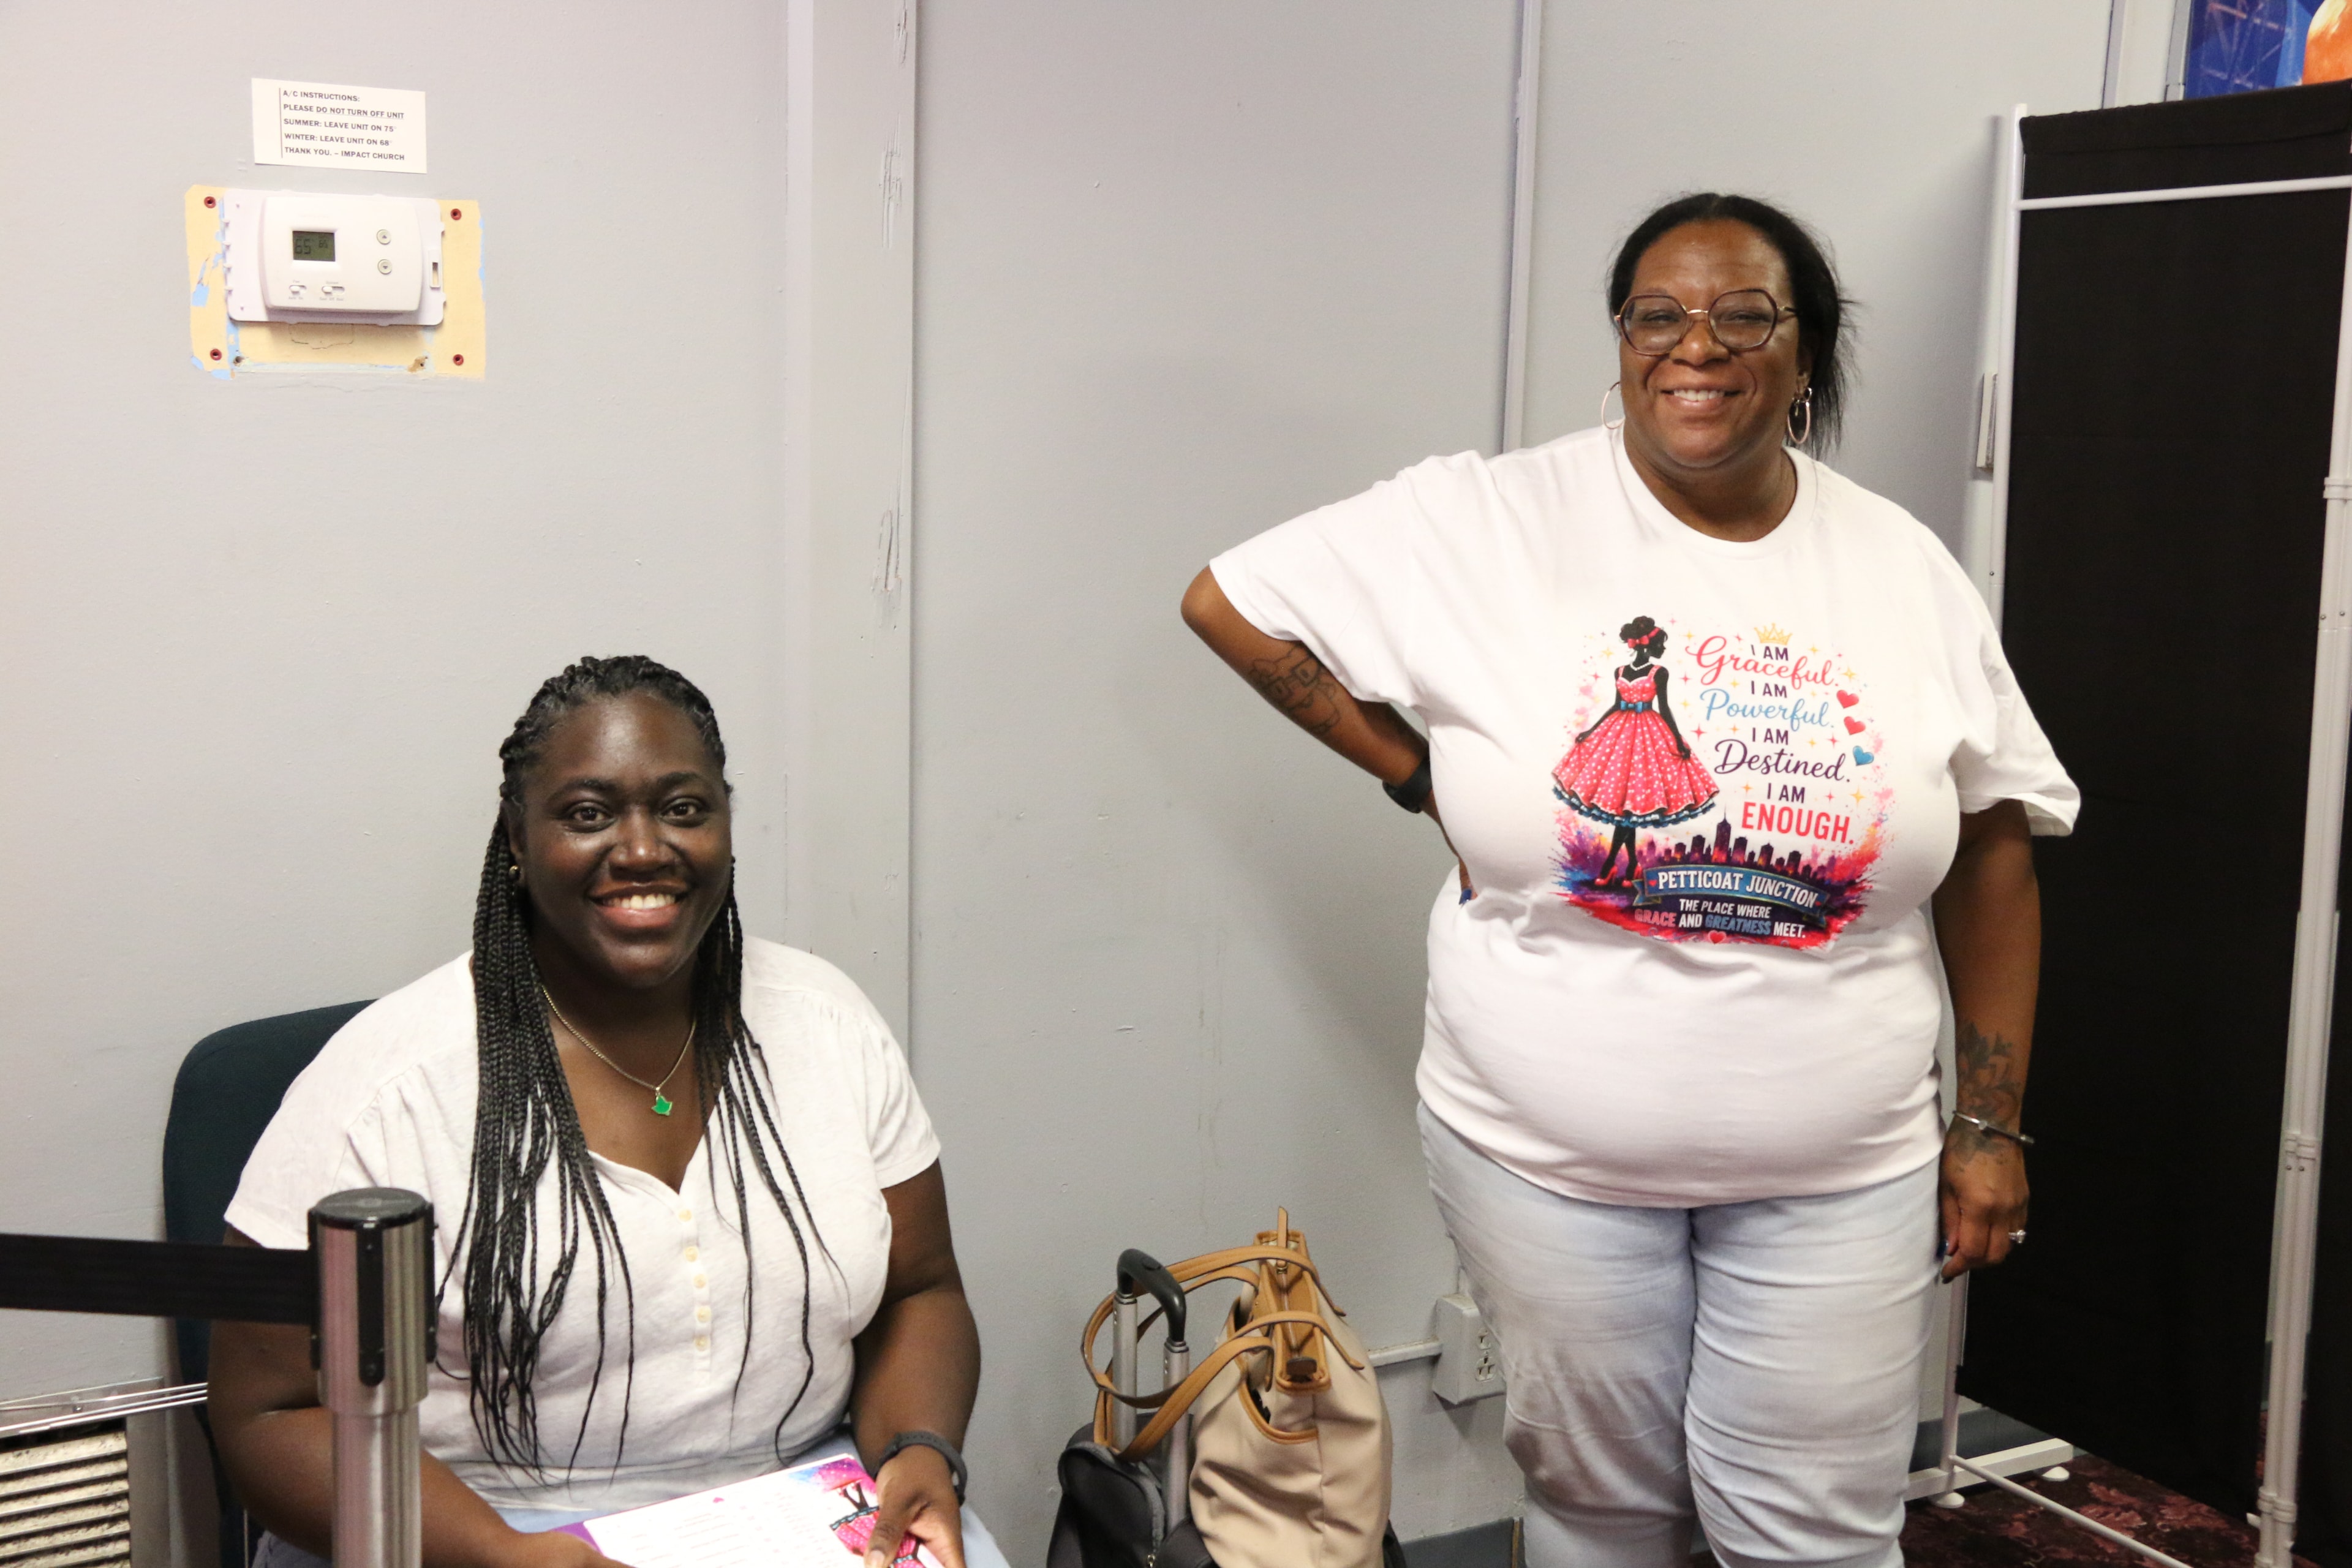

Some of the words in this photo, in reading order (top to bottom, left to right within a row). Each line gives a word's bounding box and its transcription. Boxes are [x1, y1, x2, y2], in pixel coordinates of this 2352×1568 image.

[301, 91, 360, 102] INSTRUCTIONS:
[1685, 636, 1839, 690] Graceful.
[1751, 644, 1756, 656] I
[1763, 646, 1789, 661] AM
[1751, 680, 1755, 695] I
[1762, 683, 1787, 698] AM
[1700, 688, 1834, 732] Powerful.
[1752, 727, 1756, 742] I
[1763, 728, 1789, 745] AM
[1714, 739, 1850, 782] Destined.
[1767, 783, 1772, 799] I
[1779, 785, 1805, 804] AM
[1741, 801, 1854, 845] ENOUGH.
[1657, 870, 1744, 890] PETTICOAT
[1746, 875, 1819, 908] JUNCTION
[1679, 899, 1699, 912] THE
[1700, 900, 1735, 916] PLACE
[1736, 904, 1772, 919] WHERE
[1634, 908, 1677, 927] GRACE
[1678, 914, 1702, 928] AND
[1705, 914, 1771, 935] GREATNESS
[1773, 921, 1806, 938] MEET.
